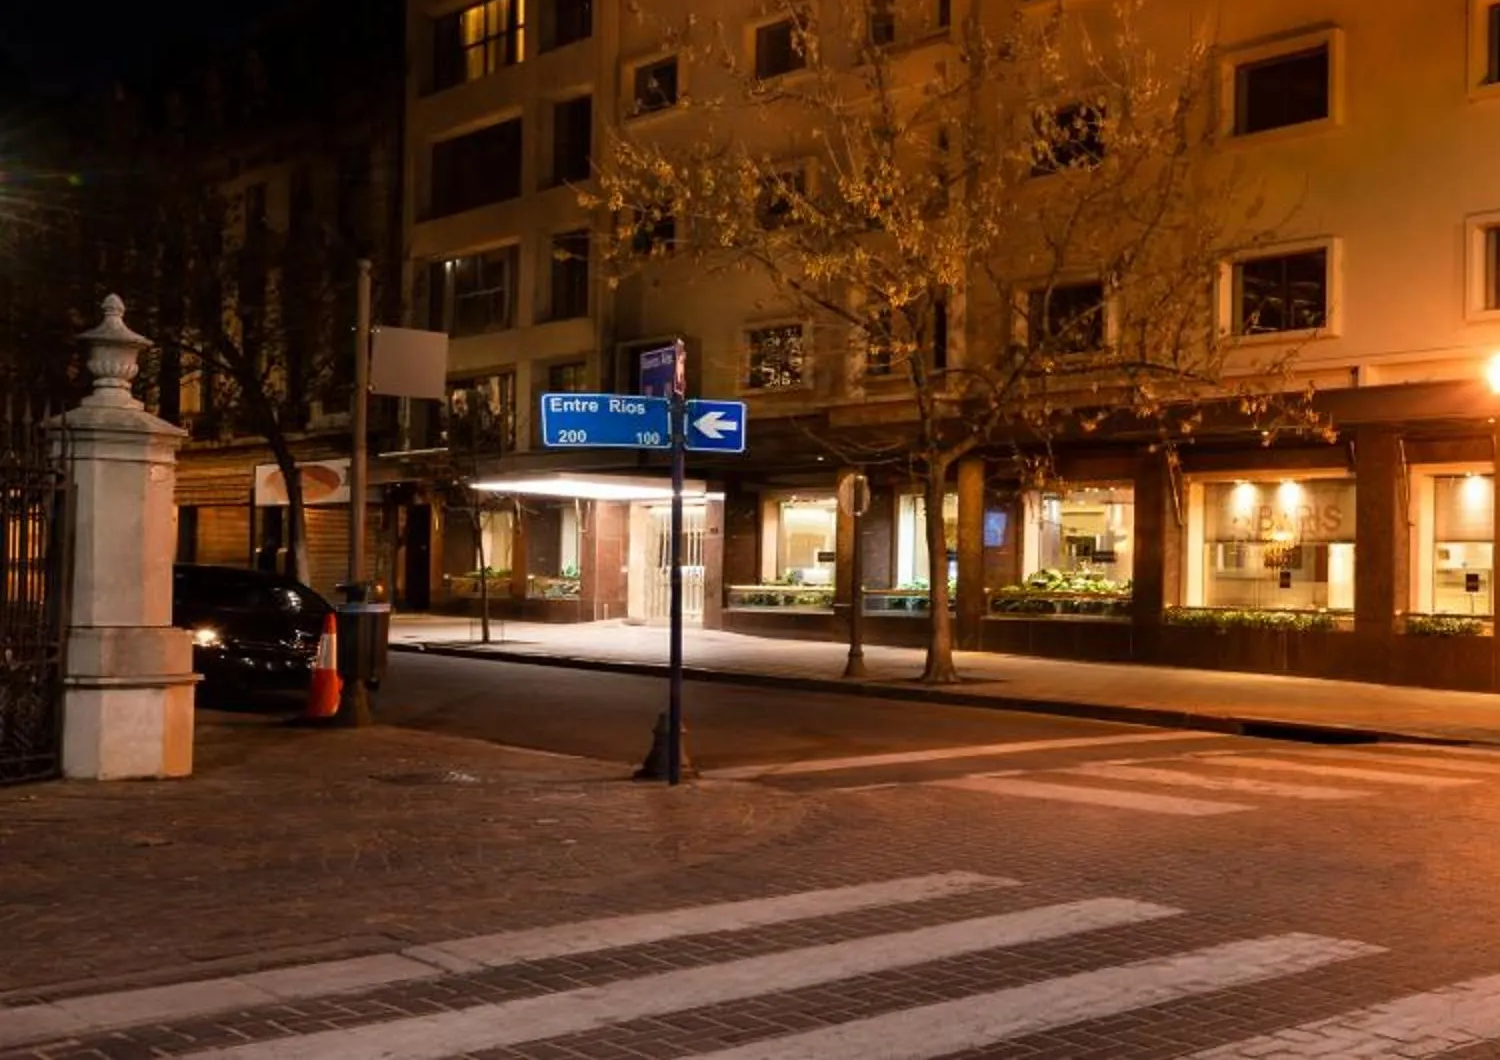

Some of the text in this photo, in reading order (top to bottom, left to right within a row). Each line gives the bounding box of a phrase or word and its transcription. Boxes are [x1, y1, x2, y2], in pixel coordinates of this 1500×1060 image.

[550, 398, 646, 415] Entre Rios
[557, 429, 661, 445] 200 100
